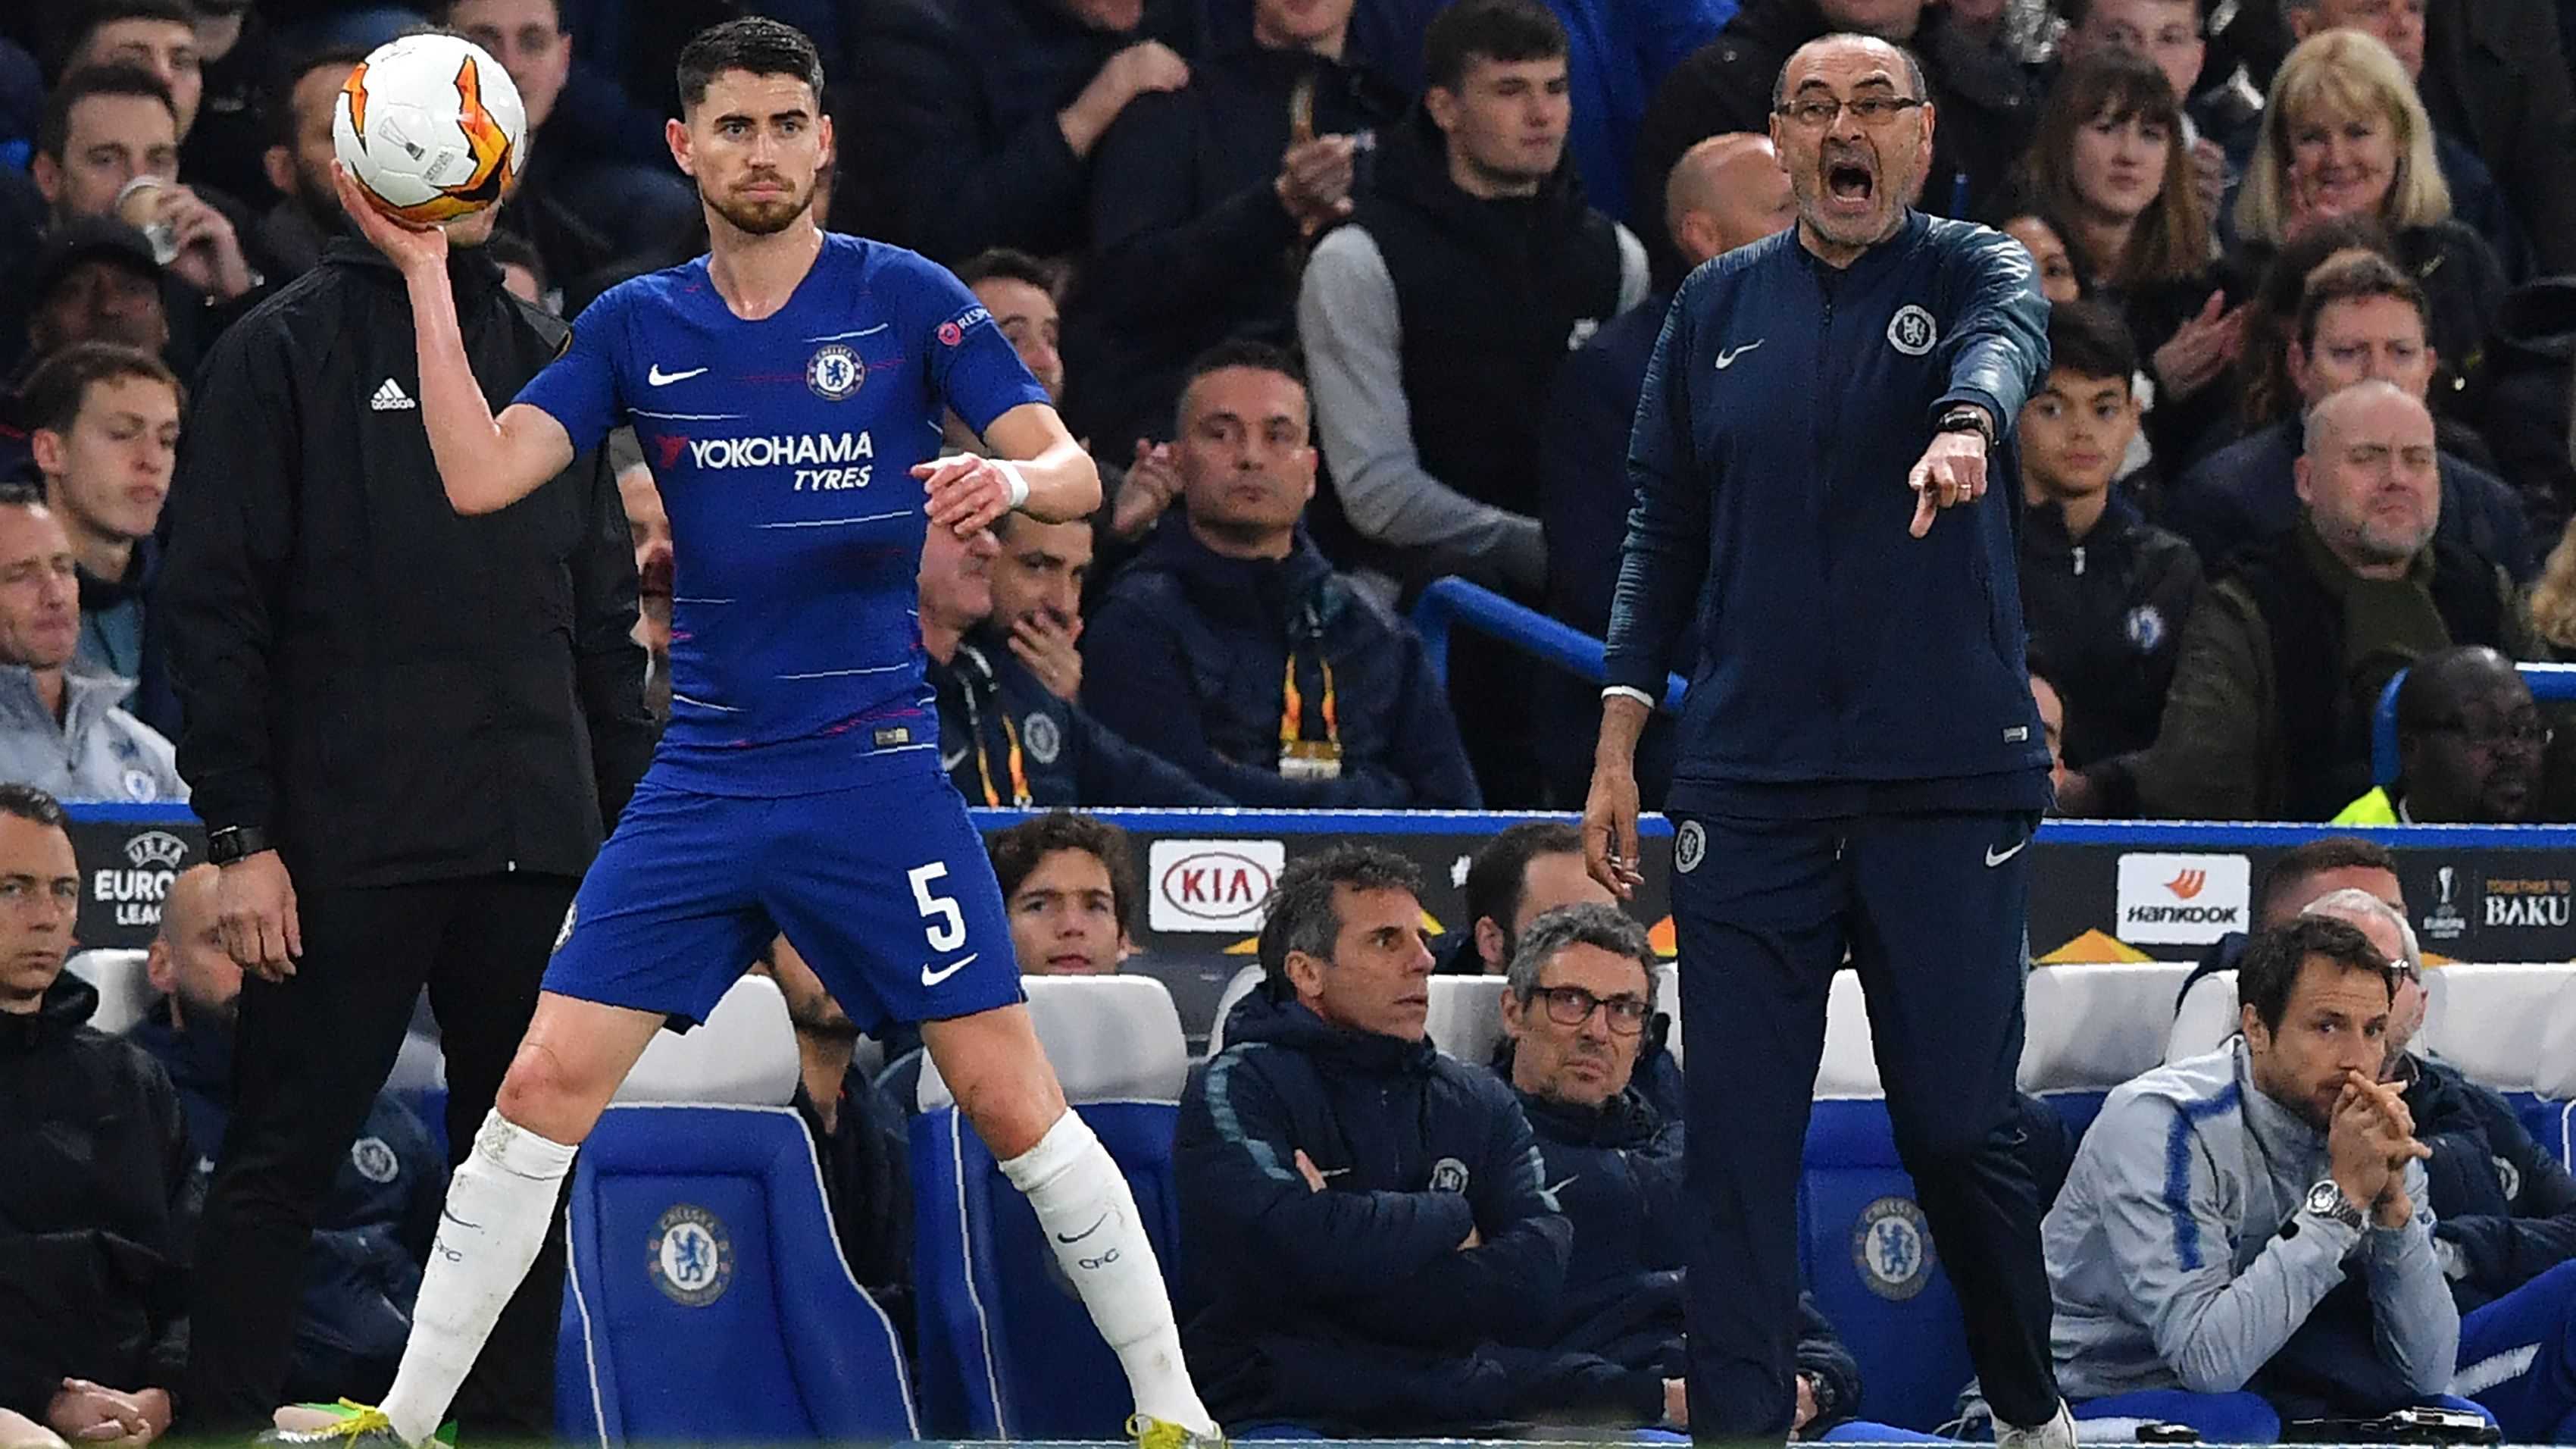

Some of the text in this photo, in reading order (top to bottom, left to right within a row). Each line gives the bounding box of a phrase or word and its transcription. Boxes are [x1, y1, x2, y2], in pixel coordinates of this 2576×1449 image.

[957, 308, 993, 330] RESP
[370, 398, 416, 410] adidas
[689, 430, 874, 469] YOKOHAMA
[794, 465, 873, 491] TYRES
[128, 837, 183, 865] UEFA
[95, 869, 176, 901] EURO
[1182, 868, 1252, 903] KIA
[907, 861, 966, 953] 5
[2485, 895, 2571, 926] BAKU
